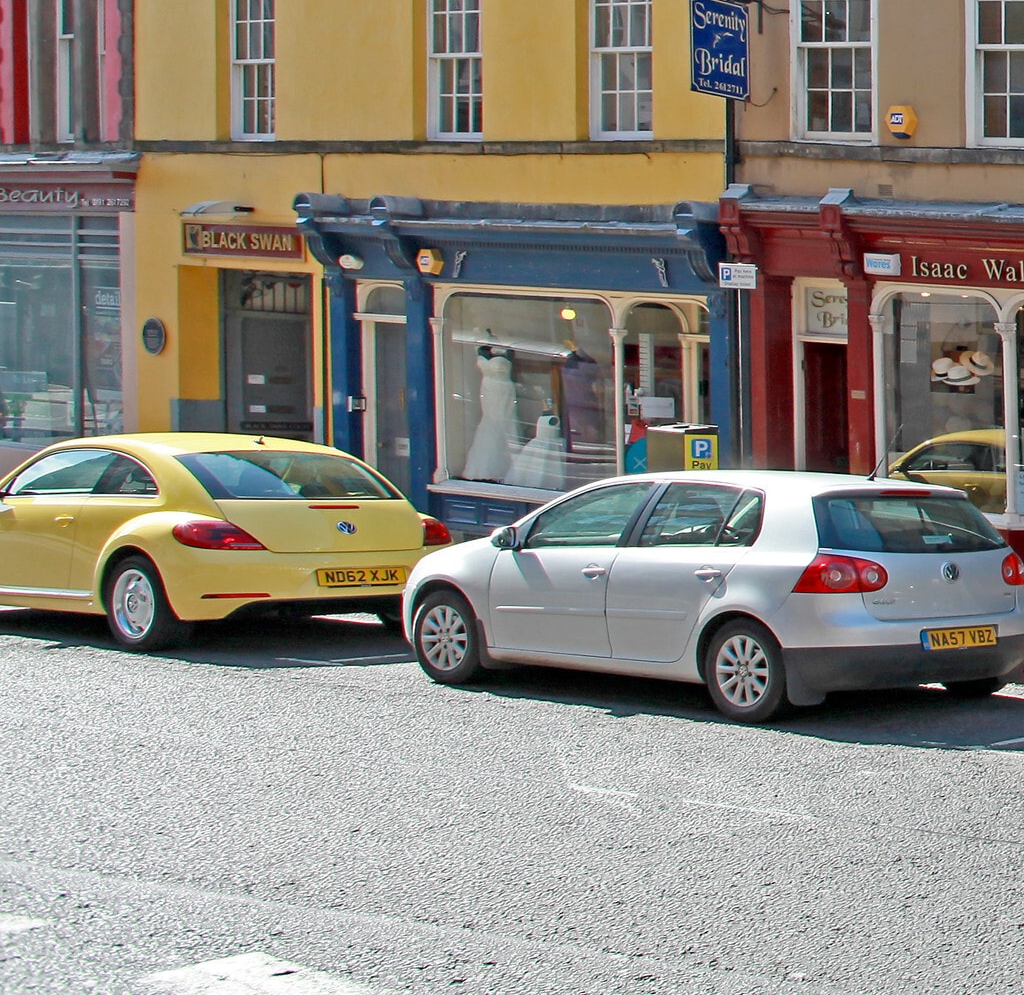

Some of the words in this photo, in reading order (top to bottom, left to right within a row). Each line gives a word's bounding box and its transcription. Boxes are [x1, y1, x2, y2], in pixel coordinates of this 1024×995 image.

[694, 2, 746, 42] Serenity
[695, 47, 746, 77] Bridal
[714, 80, 743, 95] 2612711
[202, 230, 248, 250] BLACK
[250, 233, 292, 251] SWAN
[865, 257, 892, 270] Wares
[911, 256, 968, 280] Isaac
[692, 460, 712, 470] Pay
[325, 570, 367, 584] ND62
[370, 569, 400, 582] XJK
[930, 631, 966, 647] NA57
[969, 629, 994, 644] VBZ
